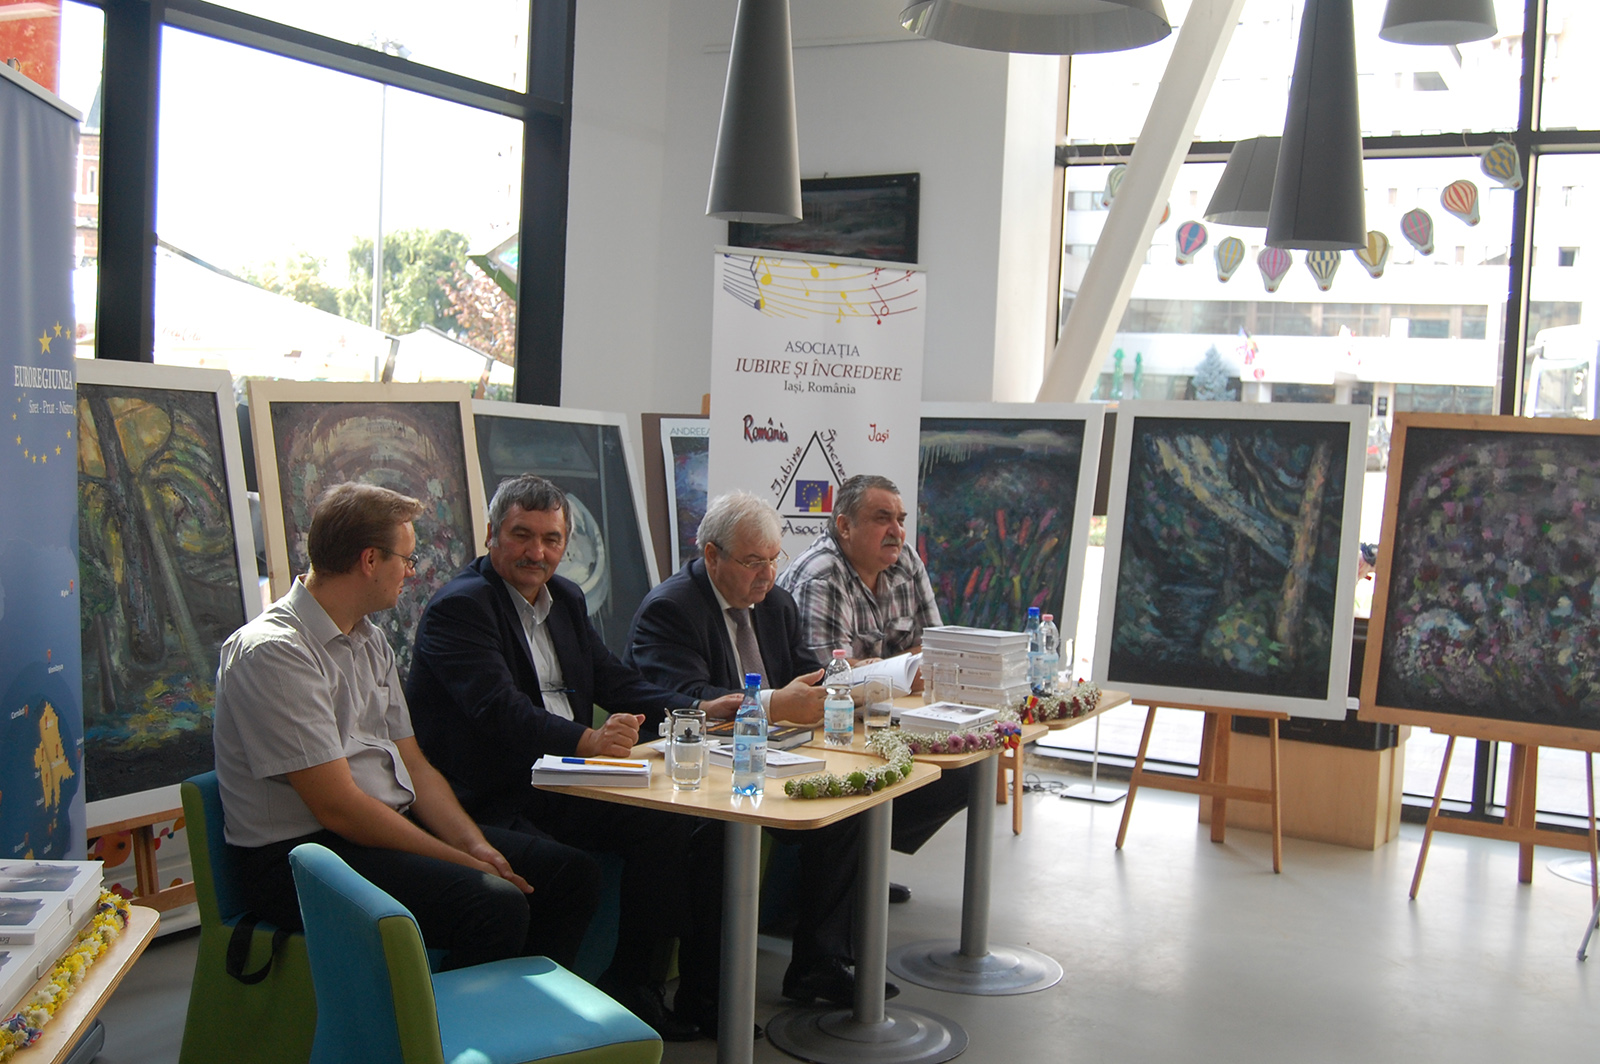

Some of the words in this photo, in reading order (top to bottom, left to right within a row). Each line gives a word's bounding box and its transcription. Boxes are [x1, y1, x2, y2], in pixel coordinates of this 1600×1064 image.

[784, 340, 861, 359] ASOCIAȚIA
[14, 365, 73, 390] EUROREGIUNEA
[735, 357, 791, 375] IUBIRE
[793, 360, 809, 379] ȘI
[811, 358, 903, 382] ÎNCREDERE
[783, 379, 805, 394] Iași,
[807, 381, 857, 395] România
[42, 400, 56, 414] Prut
[742, 414, 789, 444] România
[770, 446, 803, 497] Iubire
[781, 519, 829, 538] Asoci
